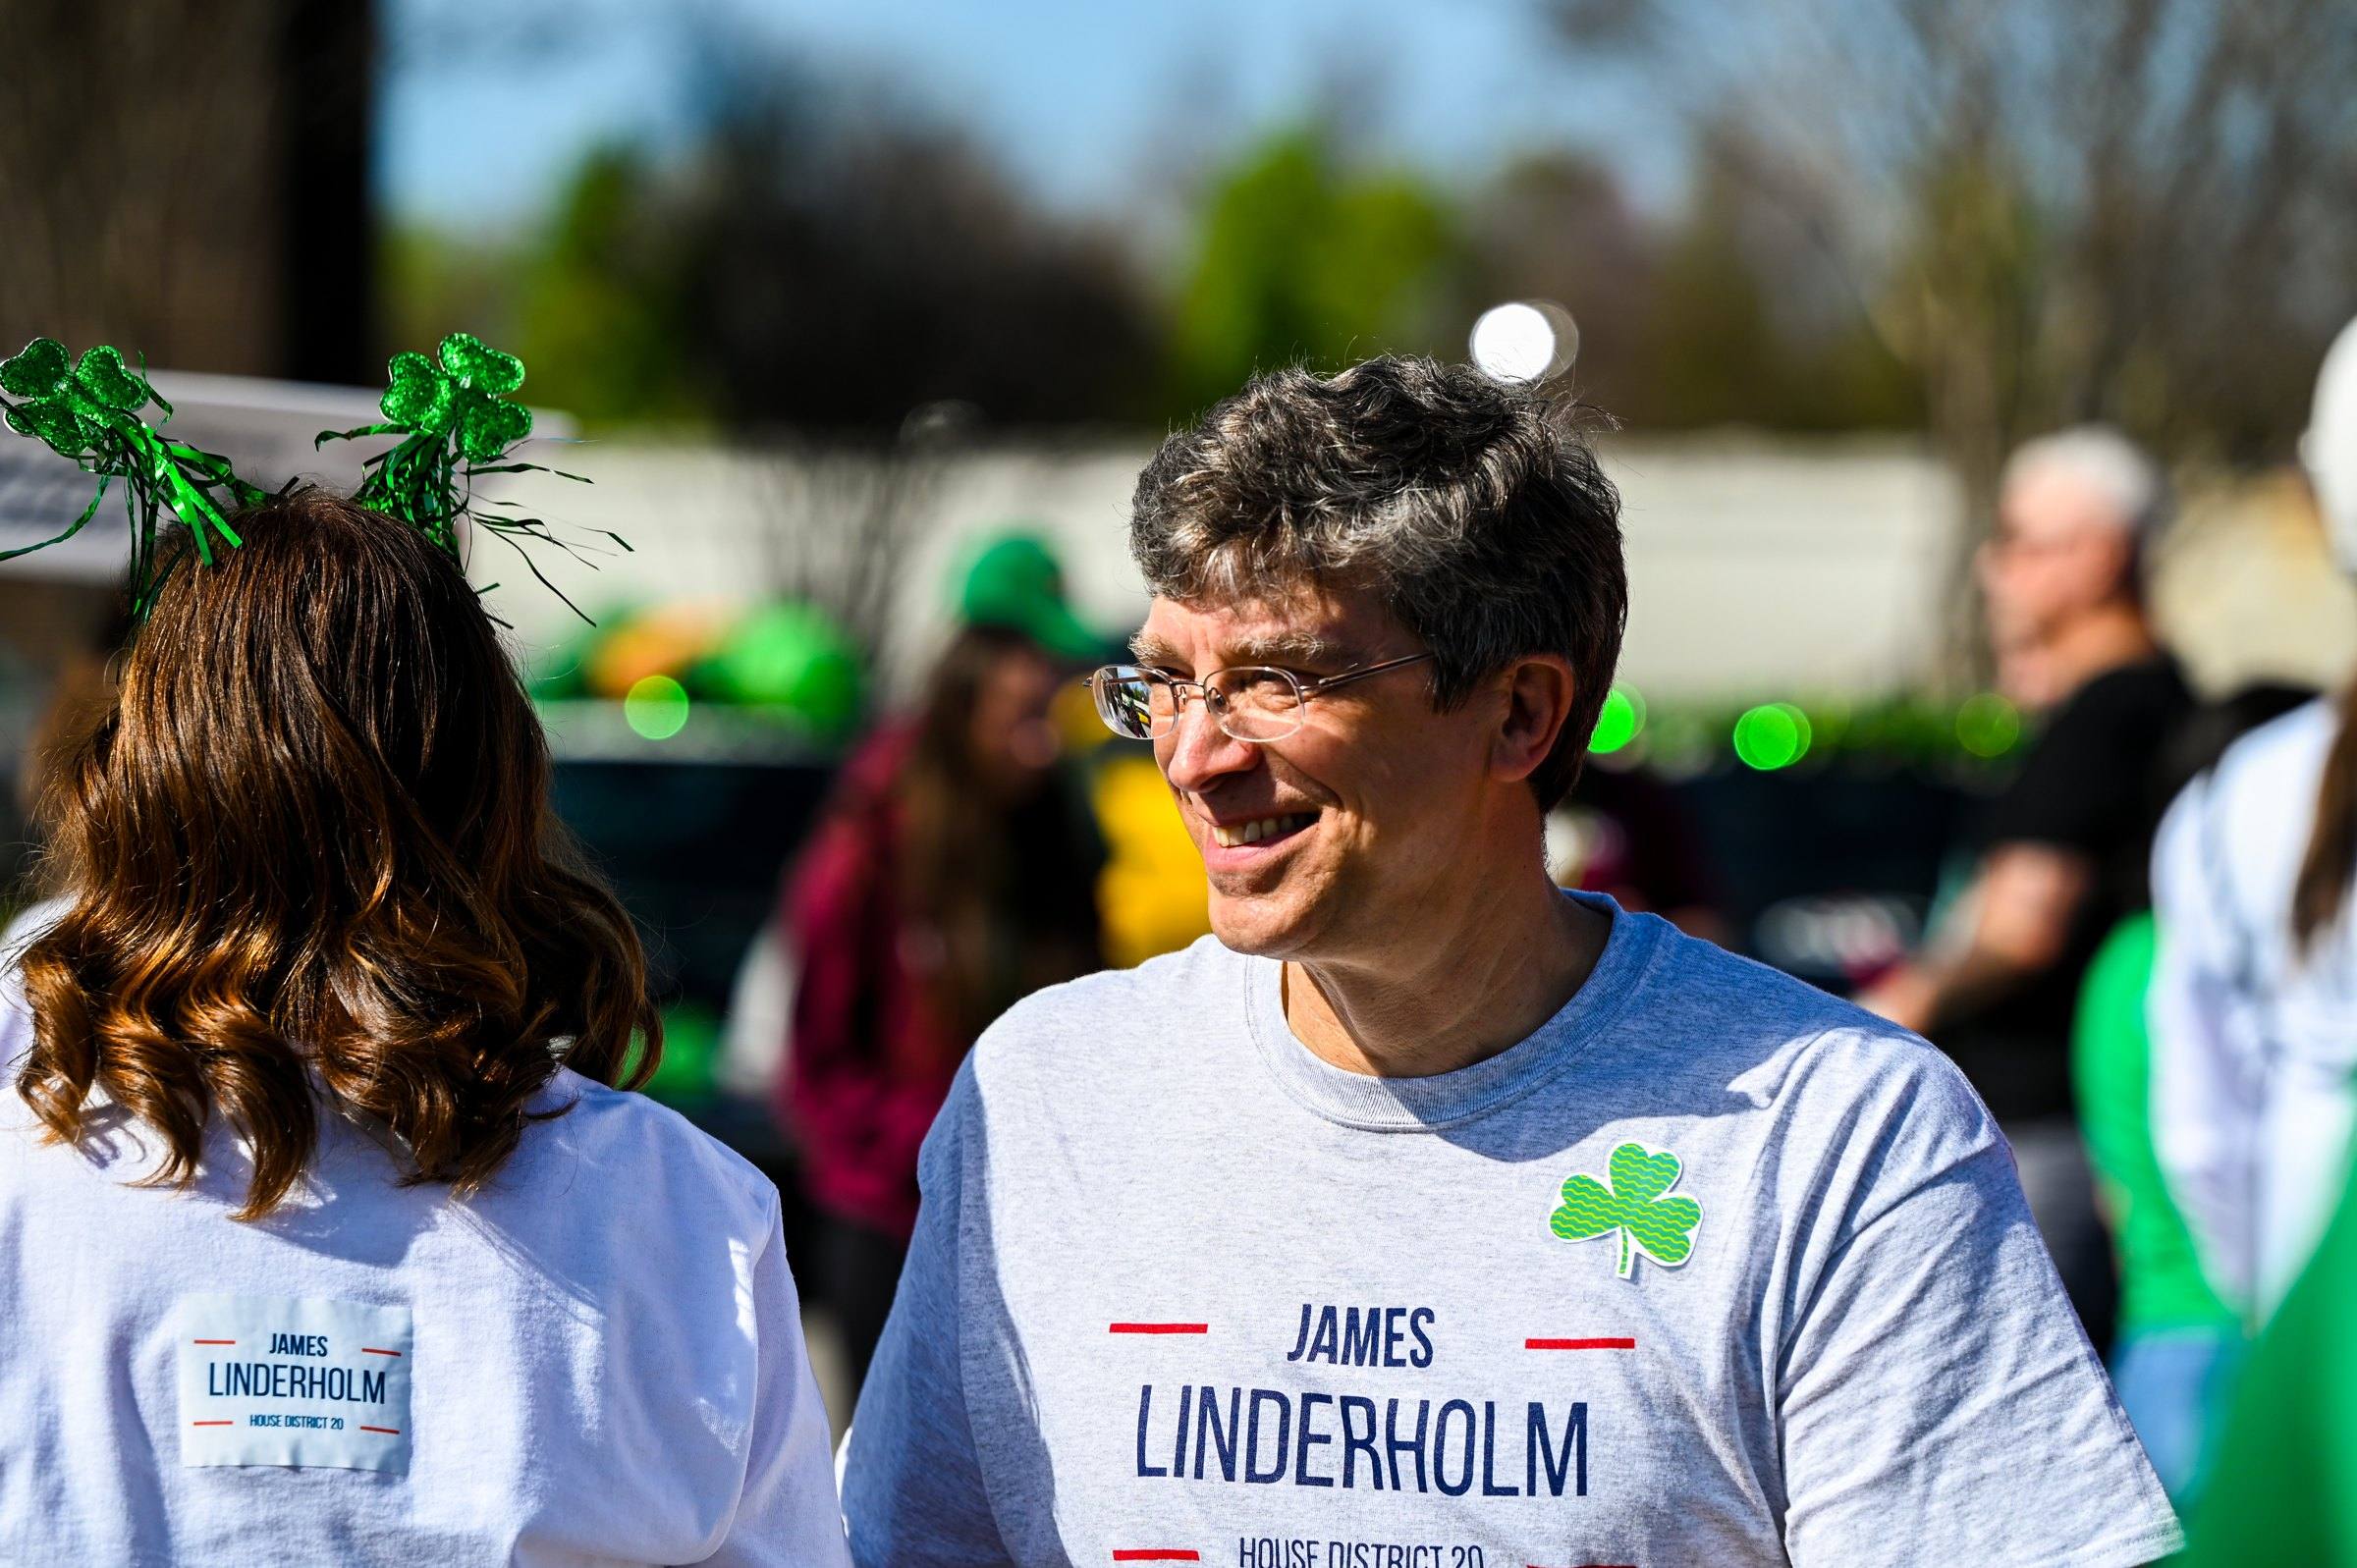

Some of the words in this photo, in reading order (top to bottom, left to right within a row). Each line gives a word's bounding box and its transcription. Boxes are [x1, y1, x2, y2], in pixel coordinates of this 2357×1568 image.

[269, 1332, 328, 1357] JAMES
[1287, 1304, 1436, 1369] JAMES
[209, 1362, 386, 1405] LINDERHOLM
[249, 1414, 282, 1428] HOUSE
[285, 1415, 328, 1430] DISTRICT
[331, 1417, 344, 1431] 20
[1136, 1384, 1588, 1497] LINDERHOLM
[1239, 1537, 1320, 1568] HOUSE
[1329, 1541, 1444, 1568] DISTRICT
[1452, 1544, 1485, 1568] 20
